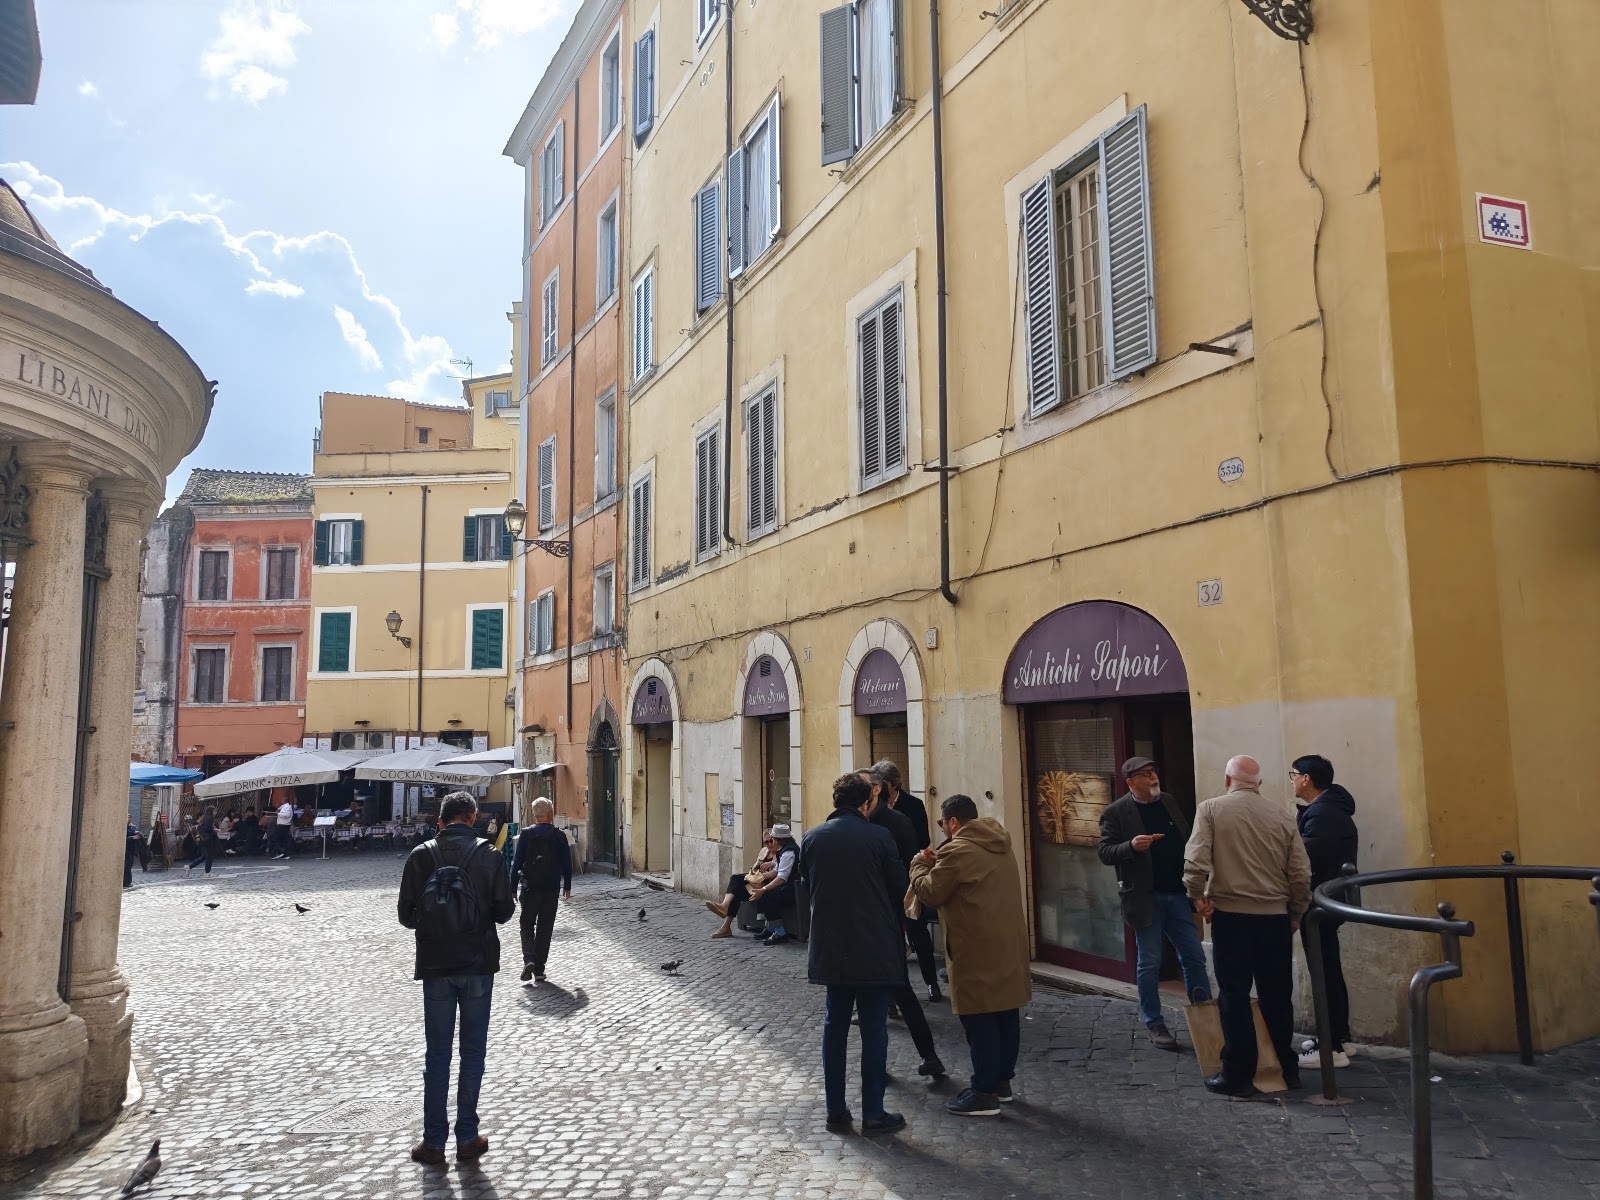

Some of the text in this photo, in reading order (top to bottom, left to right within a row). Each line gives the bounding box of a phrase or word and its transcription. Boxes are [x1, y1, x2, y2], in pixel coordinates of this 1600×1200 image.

[17, 353, 110, 420] LIBANI
[1200, 582, 1221, 603] 32
[1013, 640, 1169, 692] Antichi Sapori
[860, 677, 901, 695] Urbani
[234, 775, 302, 792] DRINK PIZZA
[379, 769, 468, 785] COCKTAILS WINE
